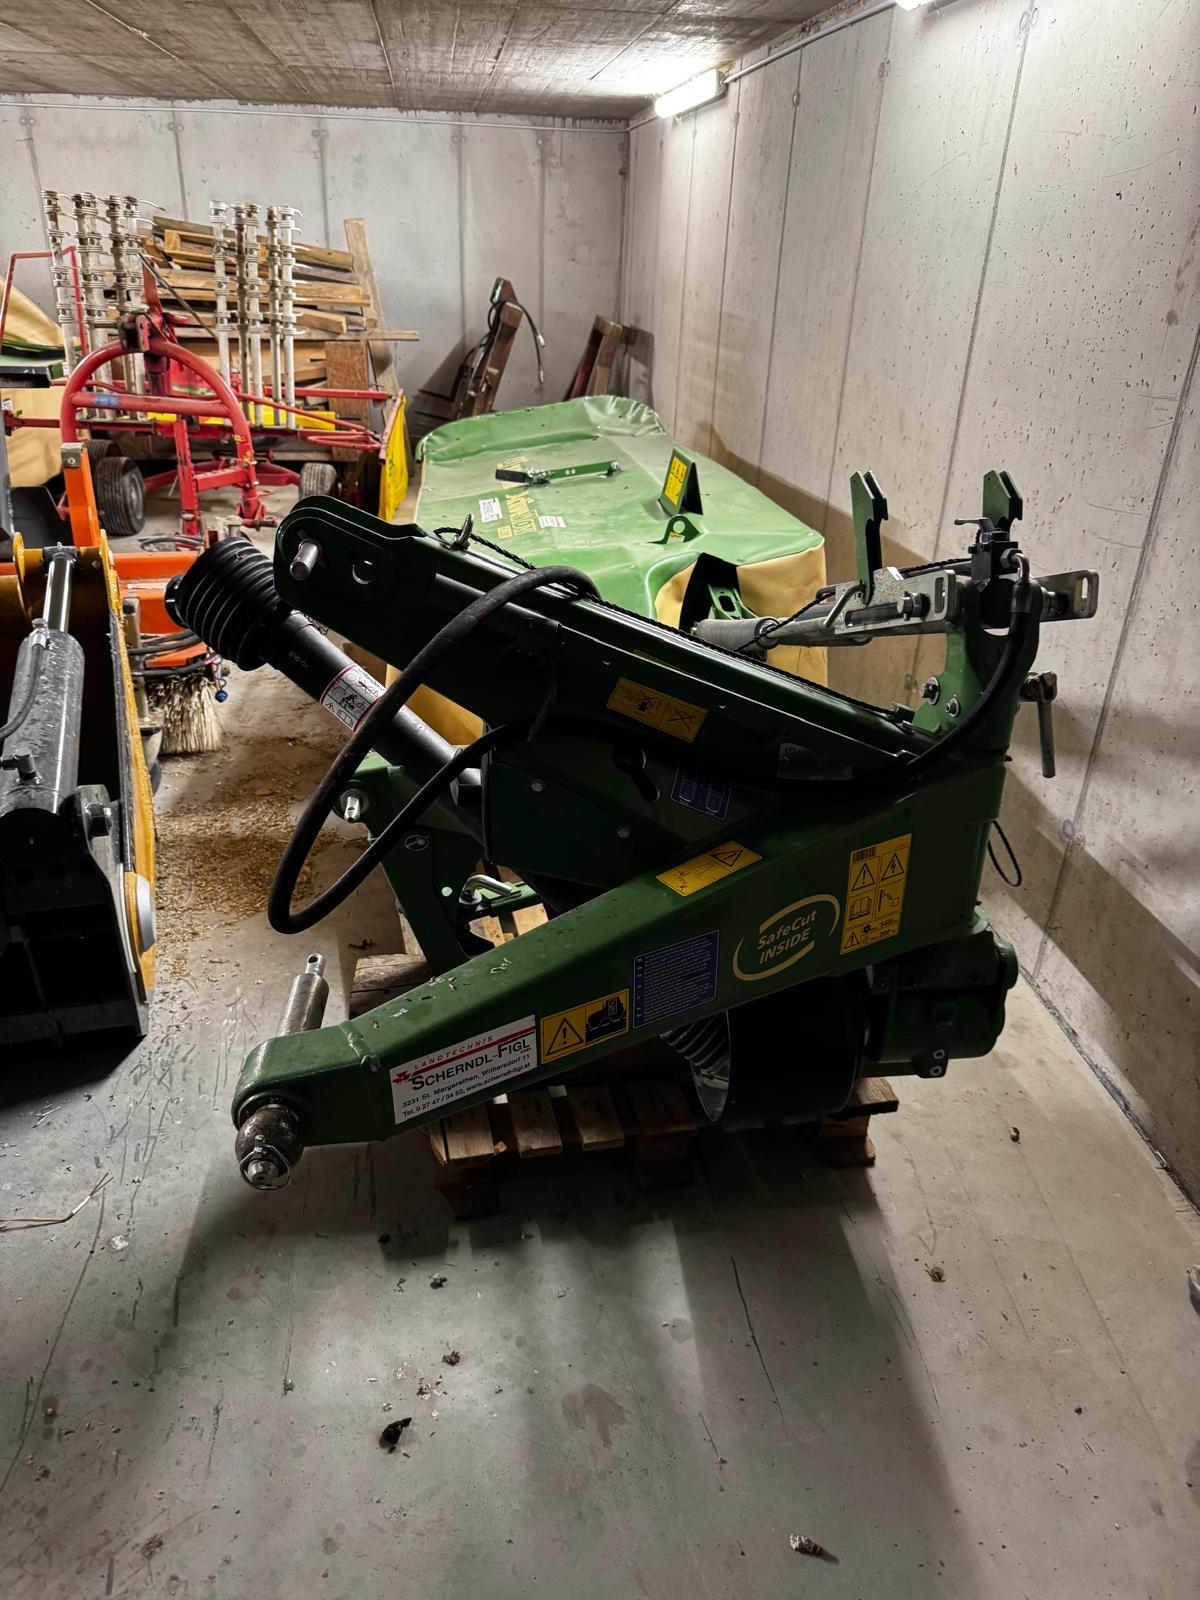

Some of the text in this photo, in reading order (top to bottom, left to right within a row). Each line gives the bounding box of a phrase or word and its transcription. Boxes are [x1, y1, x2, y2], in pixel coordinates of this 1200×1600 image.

[757, 909, 817, 950] SafeCut
[759, 928, 811, 964] INSIDE
[410, 1039, 531, 1091] SCHERNDL-FIGL
[414, 1035, 494, 1069] LANDTECHNIK
[402, 1107, 415, 1117] Tel.
[422, 1101, 431, 1110] 27
[431, 1097, 441, 1106] 47
[403, 1097, 419, 1108] 3231
[422, 1092, 431, 1102] St.
